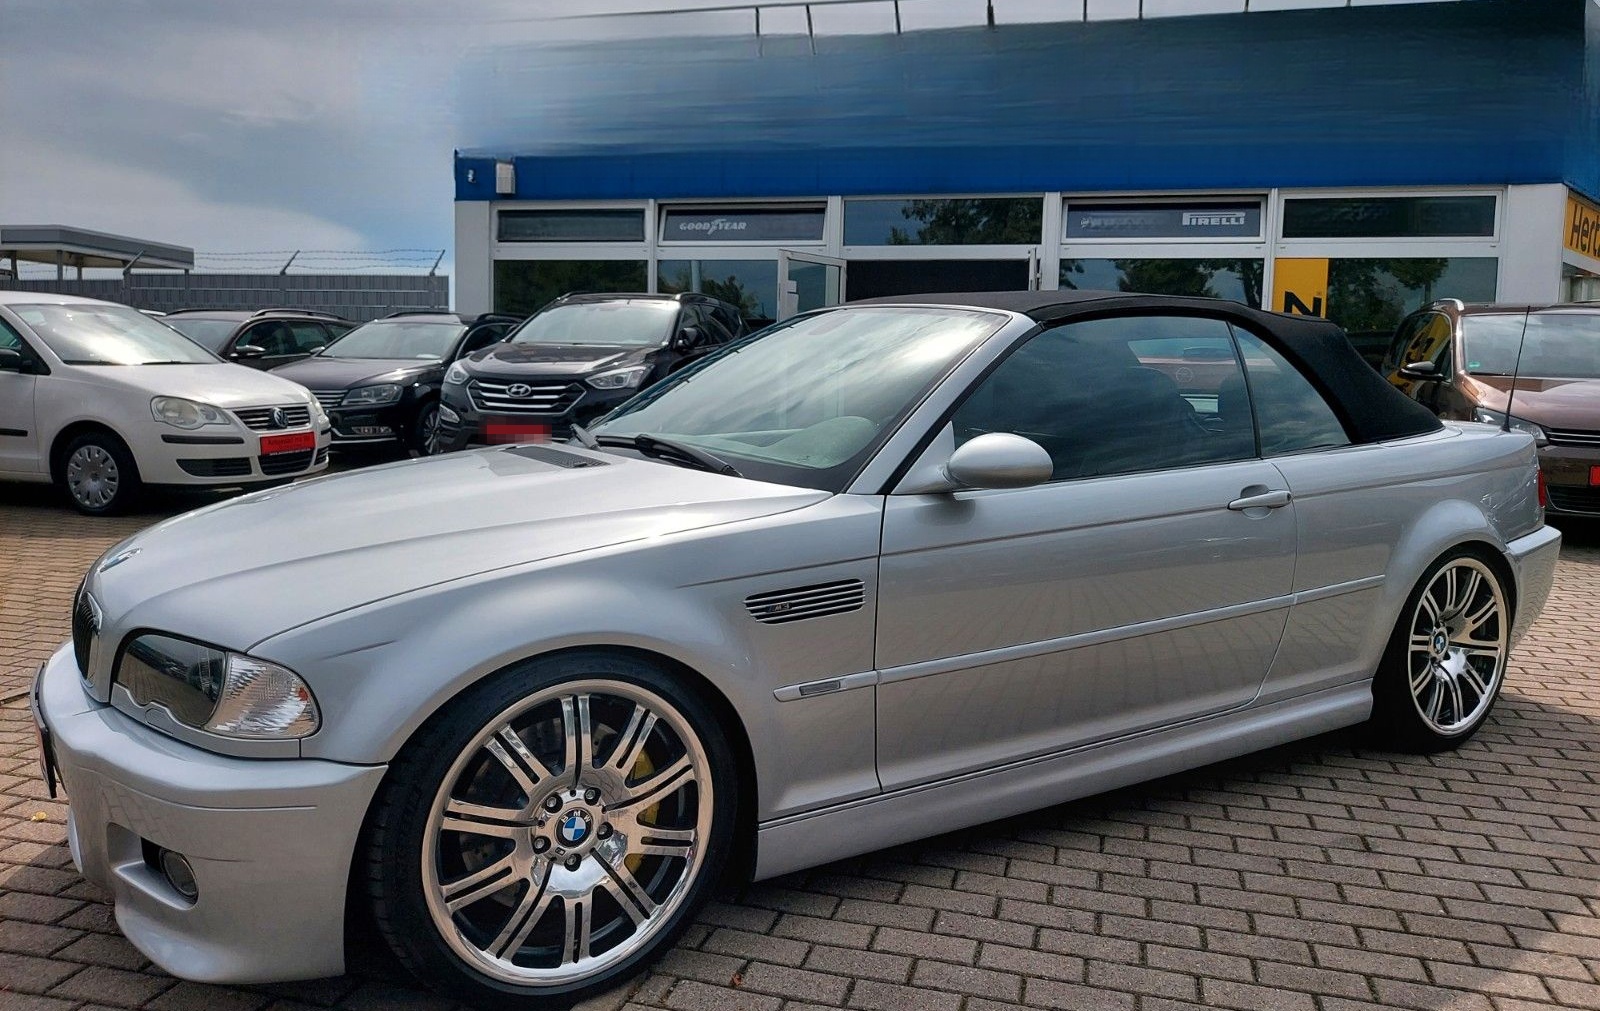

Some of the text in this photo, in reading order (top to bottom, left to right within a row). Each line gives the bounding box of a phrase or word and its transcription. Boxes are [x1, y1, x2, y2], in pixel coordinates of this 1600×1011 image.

[679, 218, 747, 235] GOODYEAR
[1182, 211, 1247, 227] PIRELLI
[1570, 203, 1600, 258] Hert
[560, 809, 591, 823] BMW
